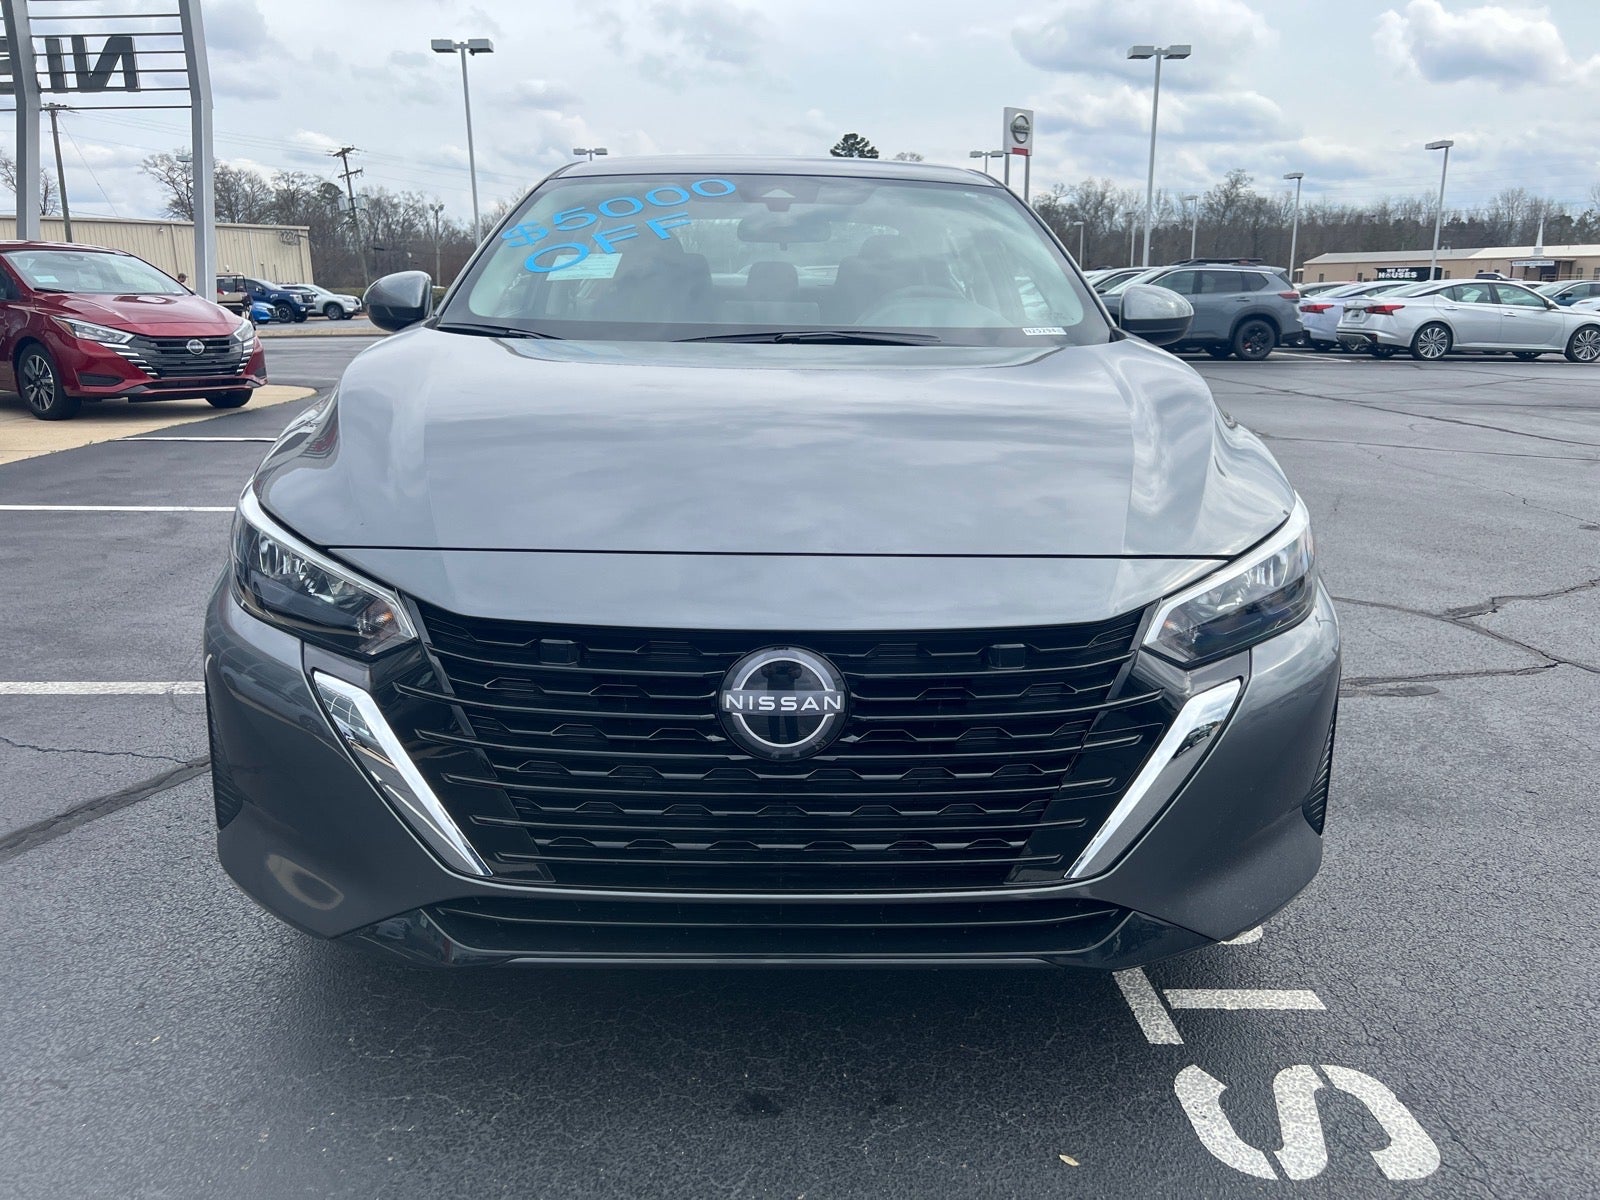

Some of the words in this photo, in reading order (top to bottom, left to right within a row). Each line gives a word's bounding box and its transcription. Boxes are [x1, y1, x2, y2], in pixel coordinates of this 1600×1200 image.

[501, 178, 736, 247] $5000
[525, 211, 691, 273] OFF
[726, 694, 841, 711] NISSAN
